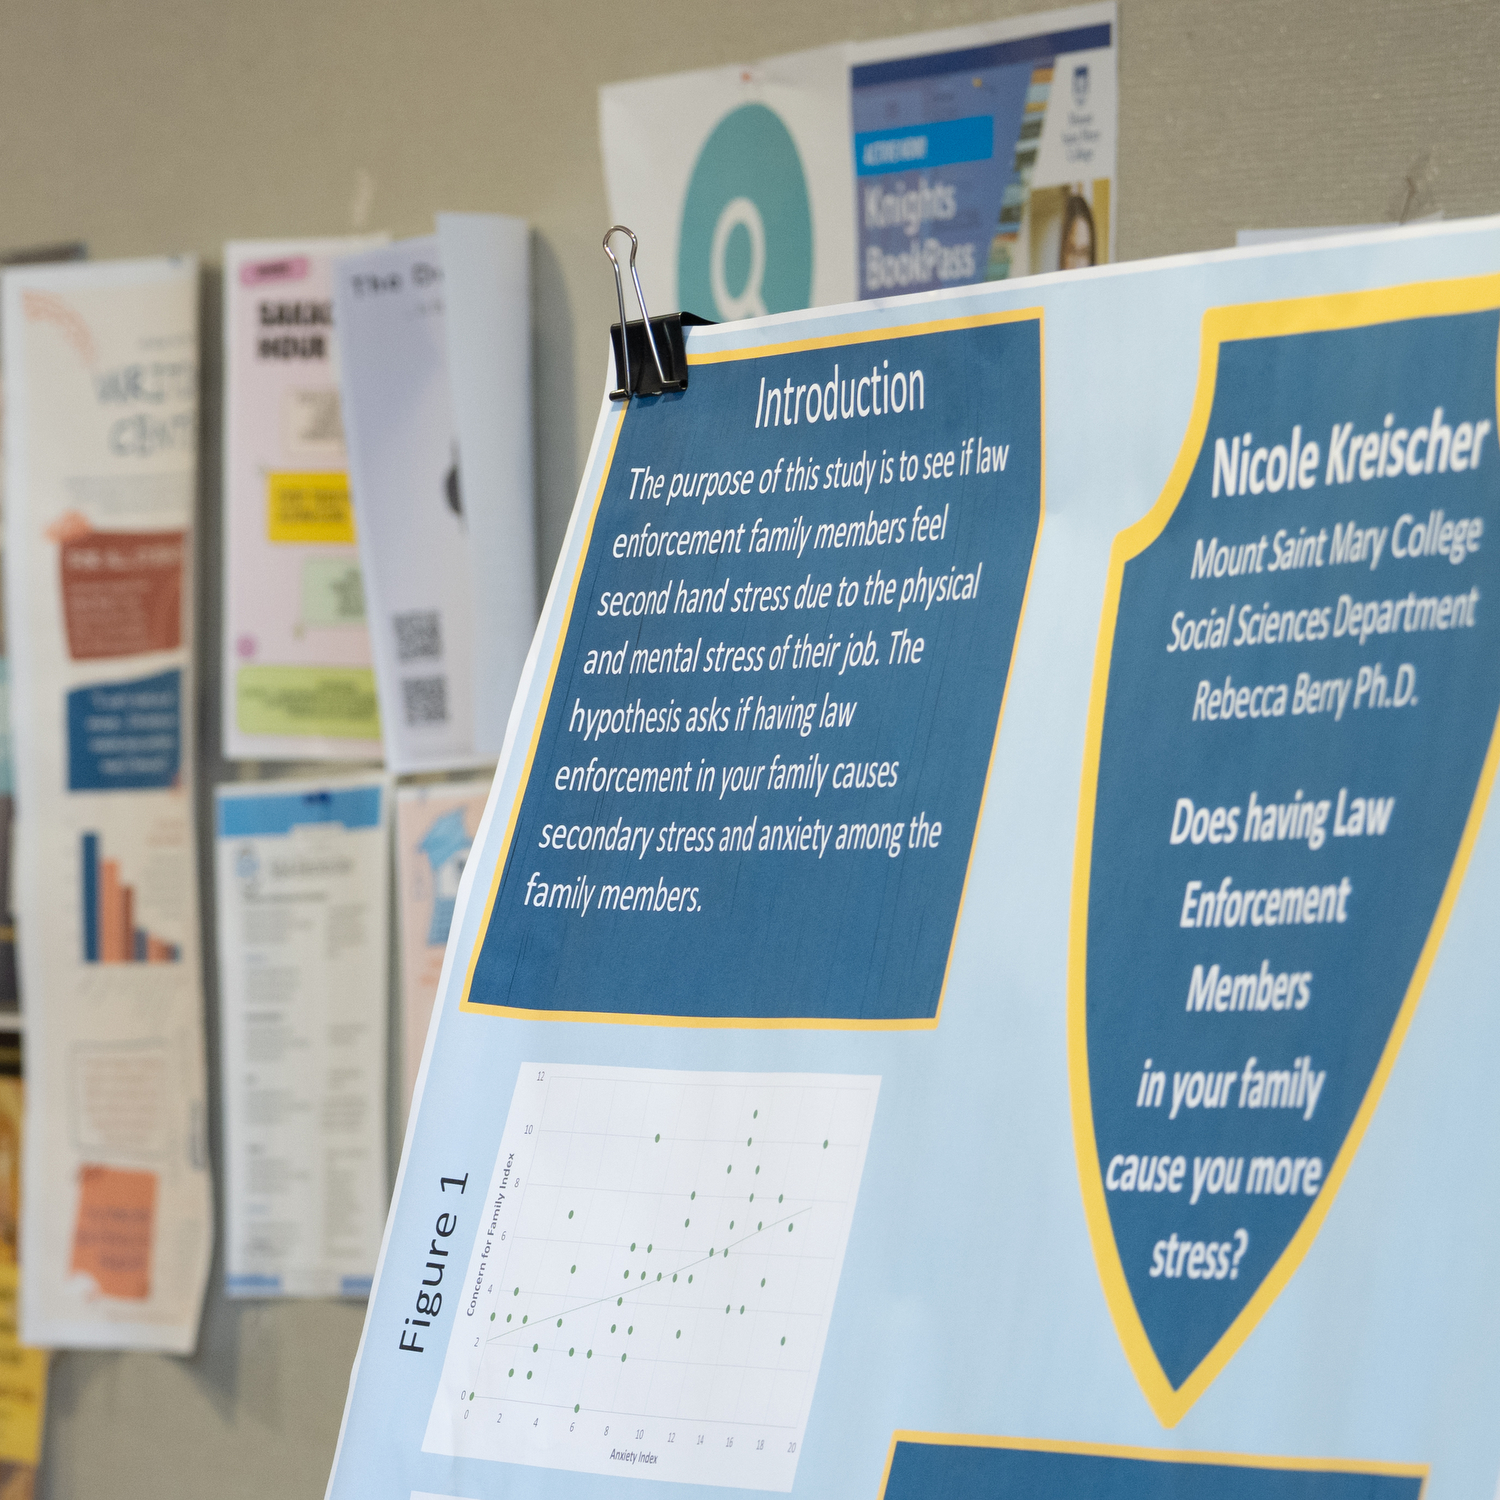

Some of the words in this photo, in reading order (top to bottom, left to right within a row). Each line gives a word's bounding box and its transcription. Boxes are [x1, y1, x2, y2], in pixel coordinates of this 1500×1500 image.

[864, 177, 957, 237] Knights
[754, 359, 925, 429] Introduction
[629, 465, 665, 500] The
[665, 469, 755, 506] purpose
[758, 457, 785, 494] of
[784, 456, 821, 493] this
[822, 449, 877, 495] study
[879, 450, 895, 484] is
[899, 450, 919, 483] to
[922, 450, 955, 480] see
[959, 437, 975, 476] if
[976, 436, 1010, 474] law
[1211, 424, 1320, 499] Nicole
[1324, 406, 1491, 486] Kreischer
[612, 522, 746, 559] enforcement
[748, 515, 813, 559] family
[813, 509, 907, 550] members
[910, 503, 950, 542] feel
[1190, 535, 1269, 580] Mount
[1267, 526, 1328, 572] Saint
[1328, 521, 1388, 570] Mary
[1391, 510, 1483, 565] College
[596, 579, 673, 617] second
[673, 577, 730, 614] hand
[730, 581, 792, 613] stress
[793, 573, 833, 610] due
[836, 576, 860, 608] to
[863, 569, 897, 606] the
[897, 561, 983, 613] physical
[1166, 604, 1236, 653] Social
[1233, 602, 1332, 647] Sciences
[1332, 588, 1479, 645] Department
[583, 640, 629, 675] and
[629, 637, 703, 674] mental
[702, 641, 766, 673] stress
[768, 634, 794, 671] of
[792, 633, 842, 670] their
[838, 630, 880, 676] job.
[888, 627, 925, 665] The
[568, 697, 682, 742] hypothesis
[685, 696, 731, 733] asks
[734, 695, 754, 732] if
[752, 695, 818, 738] having
[818, 692, 858, 728] law
[1192, 675, 1288, 721] Rebecca
[1291, 672, 1352, 721] Berry
[1353, 663, 1418, 708] Ph.D.
[554, 756, 693, 793] enforcement
[695, 758, 716, 792] in
[718, 765, 766, 801] your
[767, 752, 830, 798] family
[832, 761, 900, 789] causes
[538, 816, 655, 860] secondary
[655, 821, 716, 852] stress
[718, 815, 758, 852] and
[758, 816, 833, 859] anxiety
[835, 822, 905, 858] among
[908, 811, 942, 849] the
[1169, 797, 1241, 845] Does
[1243, 789, 1331, 851] having
[1333, 788, 1395, 837] Law
[523, 871, 597, 918] family
[597, 876, 702, 912] members.
[1179, 876, 1352, 928] Enforcement
[1185, 959, 1313, 1012] Members
[1136, 1058, 1166, 1107] in
[1168, 1071, 1238, 1120] your
[1238, 1056, 1326, 1121] family
[1105, 1154, 1187, 1193] cause
[1189, 1156, 1244, 1205] you
[1245, 1156, 1322, 1196] more
[398, 1212, 457, 1353] Figure
[440, 1172, 469, 1195] 1
[466, 1260, 487, 1317] Concern
[481, 1239, 492, 1259] for
[487, 1192, 506, 1236] Family
[499, 1153, 515, 1189] Index
[1149, 1228, 1249, 1280] stress?
[610, 1448, 638, 1465] Anxiety
[638, 1451, 658, 1464] Index
